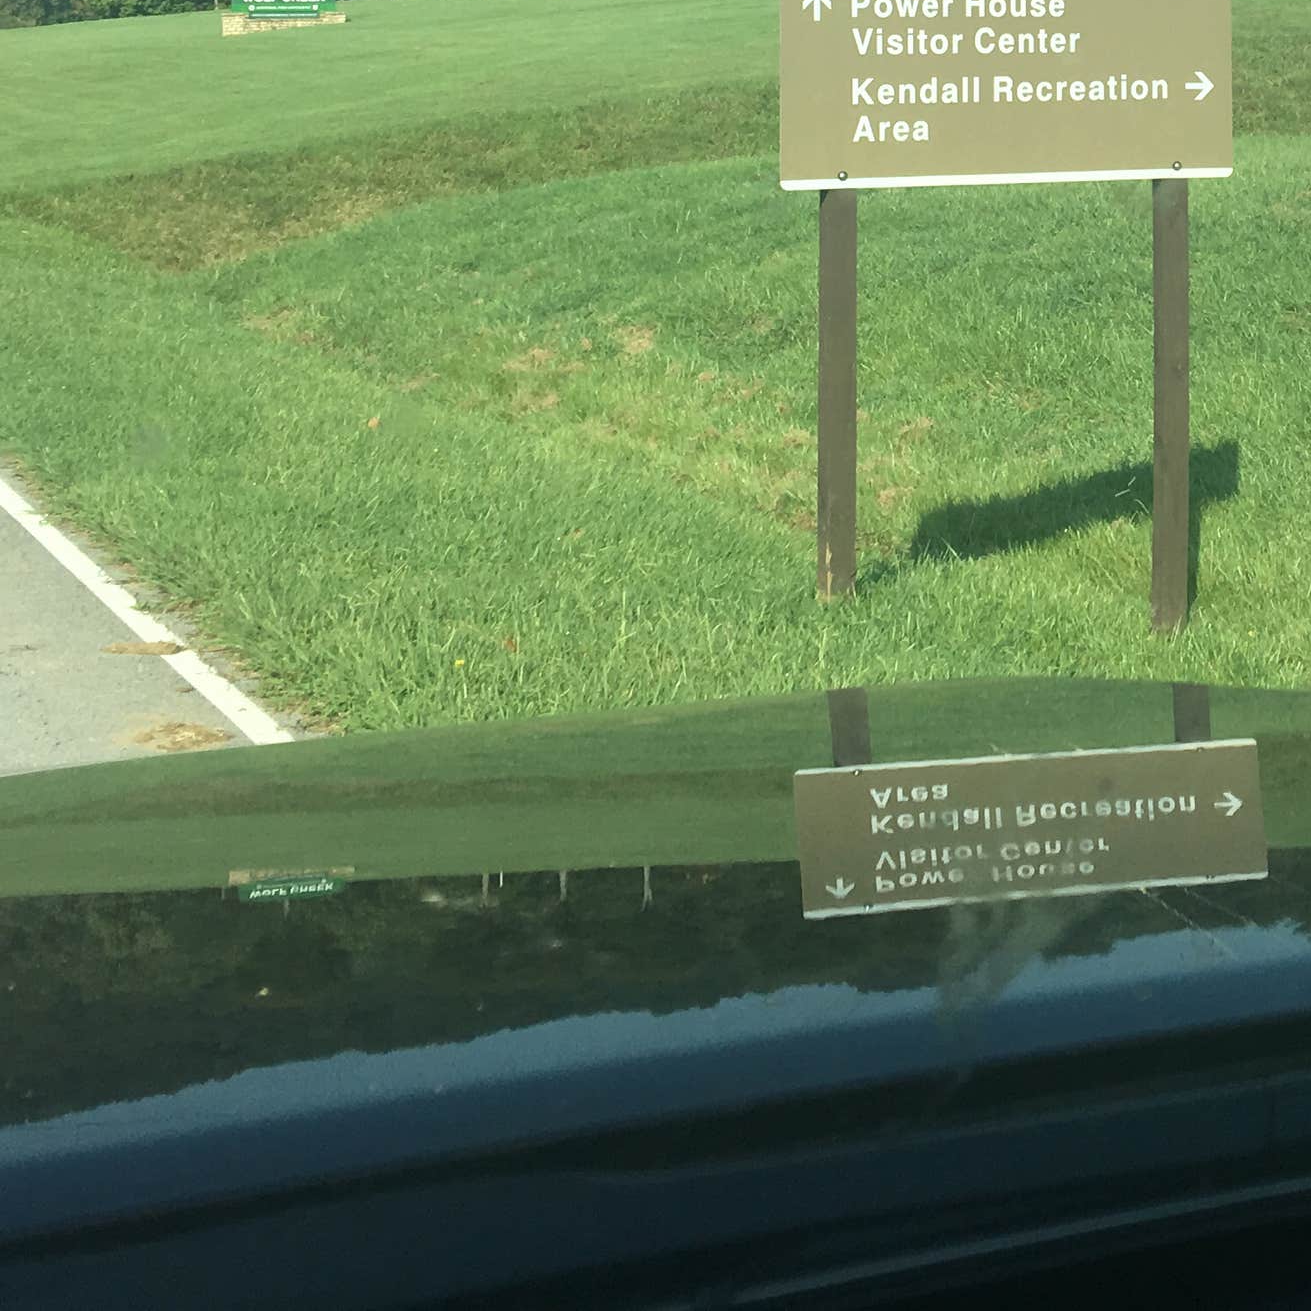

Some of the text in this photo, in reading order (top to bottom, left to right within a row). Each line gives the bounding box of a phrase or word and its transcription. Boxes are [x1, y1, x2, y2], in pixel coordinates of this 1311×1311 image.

[852, 26, 1081, 55] Visitor Center
[851, 74, 1168, 105] Kendall Recreation
[852, 115, 930, 142] Area
